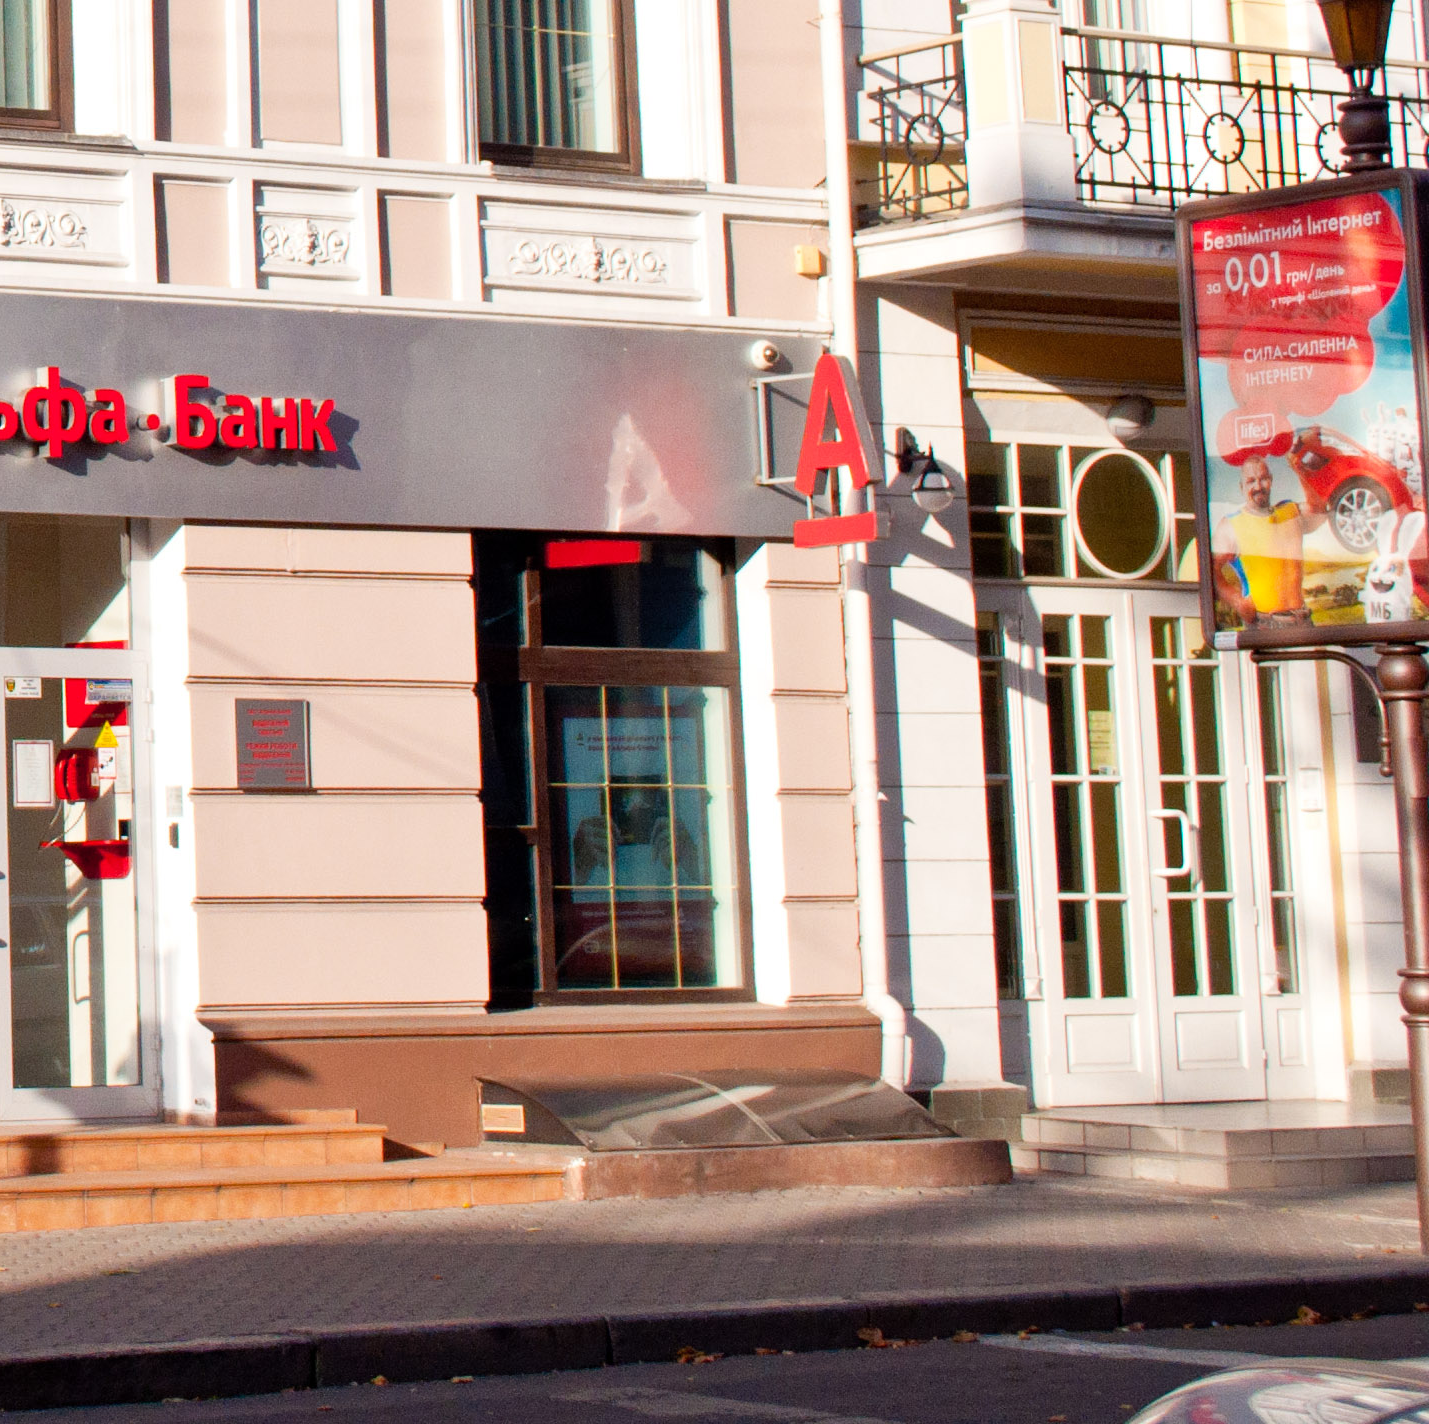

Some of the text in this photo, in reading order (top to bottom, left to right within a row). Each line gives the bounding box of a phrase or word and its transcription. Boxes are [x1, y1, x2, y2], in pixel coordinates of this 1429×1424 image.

[1203, 210, 1381, 251] Безлімітний Інтернет
[1206, 250, 1345, 296] за 0,01 грн/день
[1243, 334, 1359, 364] СИЛА-СИЛЕННА
[1246, 364, 1314, 387] ІНТЕРНЕТУ
[171, 373, 337, 453] Банк
